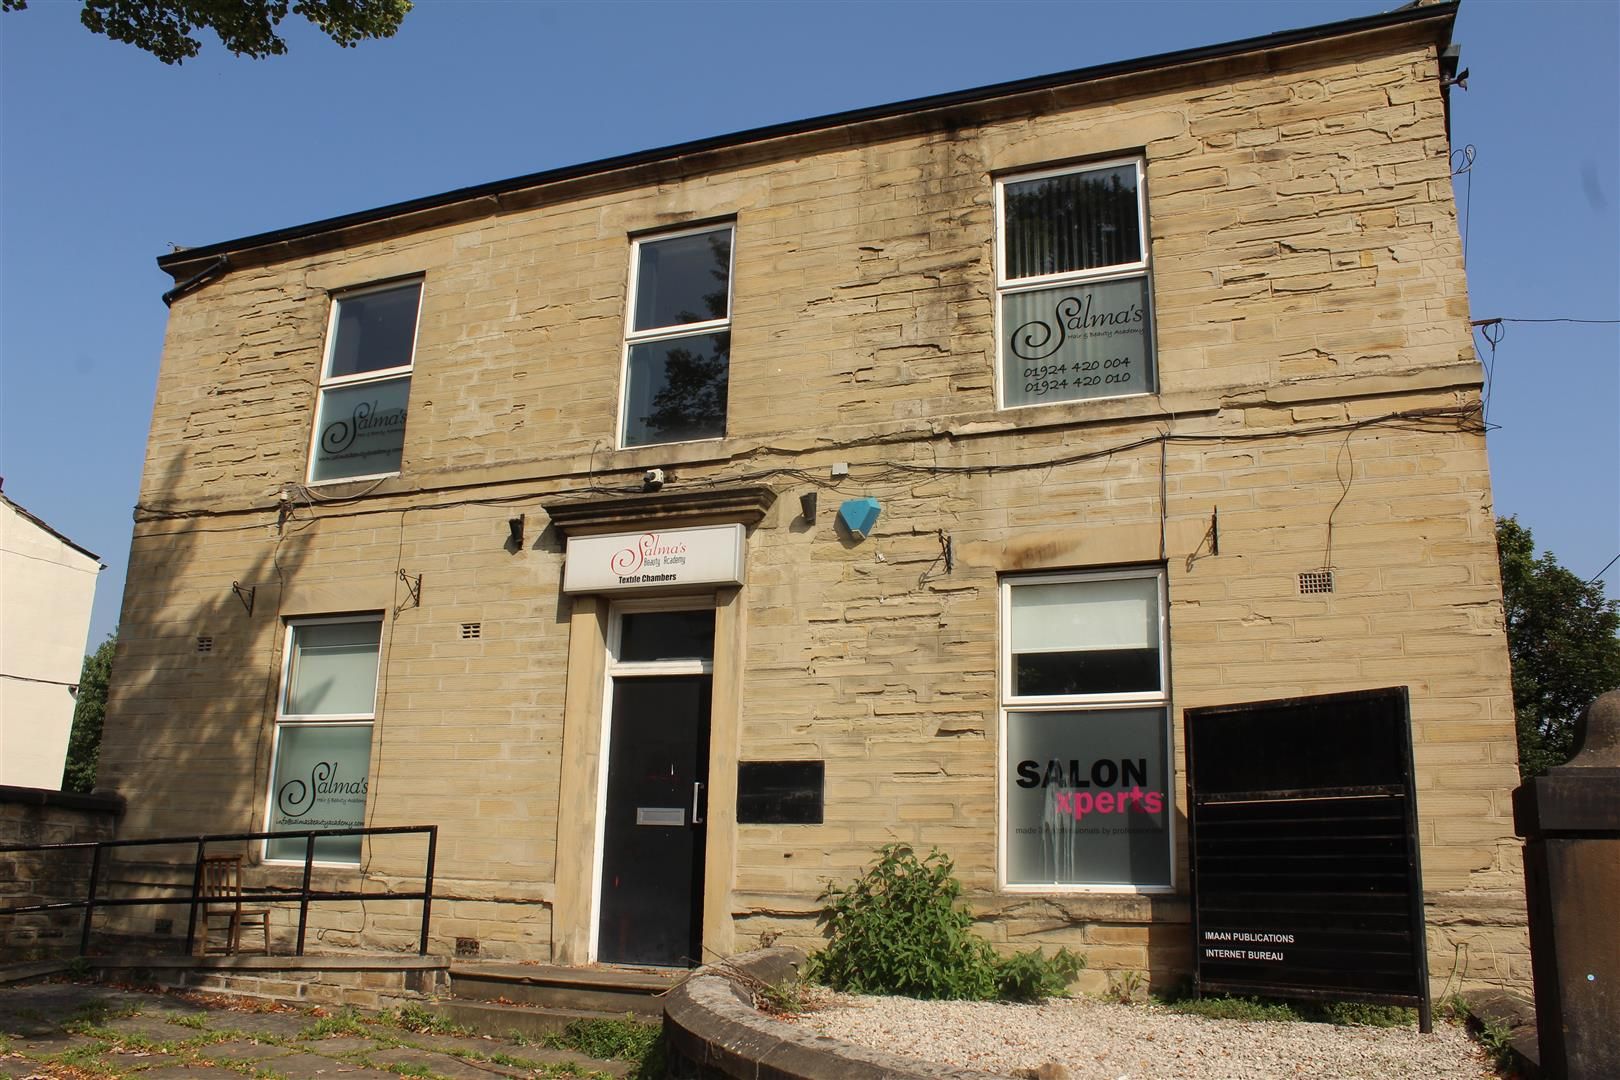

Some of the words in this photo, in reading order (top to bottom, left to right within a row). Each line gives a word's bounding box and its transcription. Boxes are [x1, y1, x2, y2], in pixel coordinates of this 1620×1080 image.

[1010, 294, 1145, 360] Salma's
[1024, 364, 1067, 381] 01924
[1071, 361, 1100, 373] 420
[1103, 357, 1131, 370] 004
[1025, 379, 1068, 395] 01924
[1073, 375, 1101, 388] 420
[1105, 372, 1131, 384] 010
[321, 399, 407, 454] Salma's
[610, 532, 687, 576] Salma's
[644, 557, 661, 567] Beauty
[663, 554, 686, 565] Academy
[618, 575, 641, 584] Textile
[641, 573, 677, 583] Chambers
[1016, 758, 1148, 789] SALON
[278, 761, 368, 817] Salma's
[1055, 784, 1164, 821] xperts
[1205, 931, 1231, 940] IMAAN
[1232, 932, 1295, 943] PUBLICATIONS
[1205, 949, 1246, 959] INTERNET
[1247, 950, 1284, 961] BUREAU
